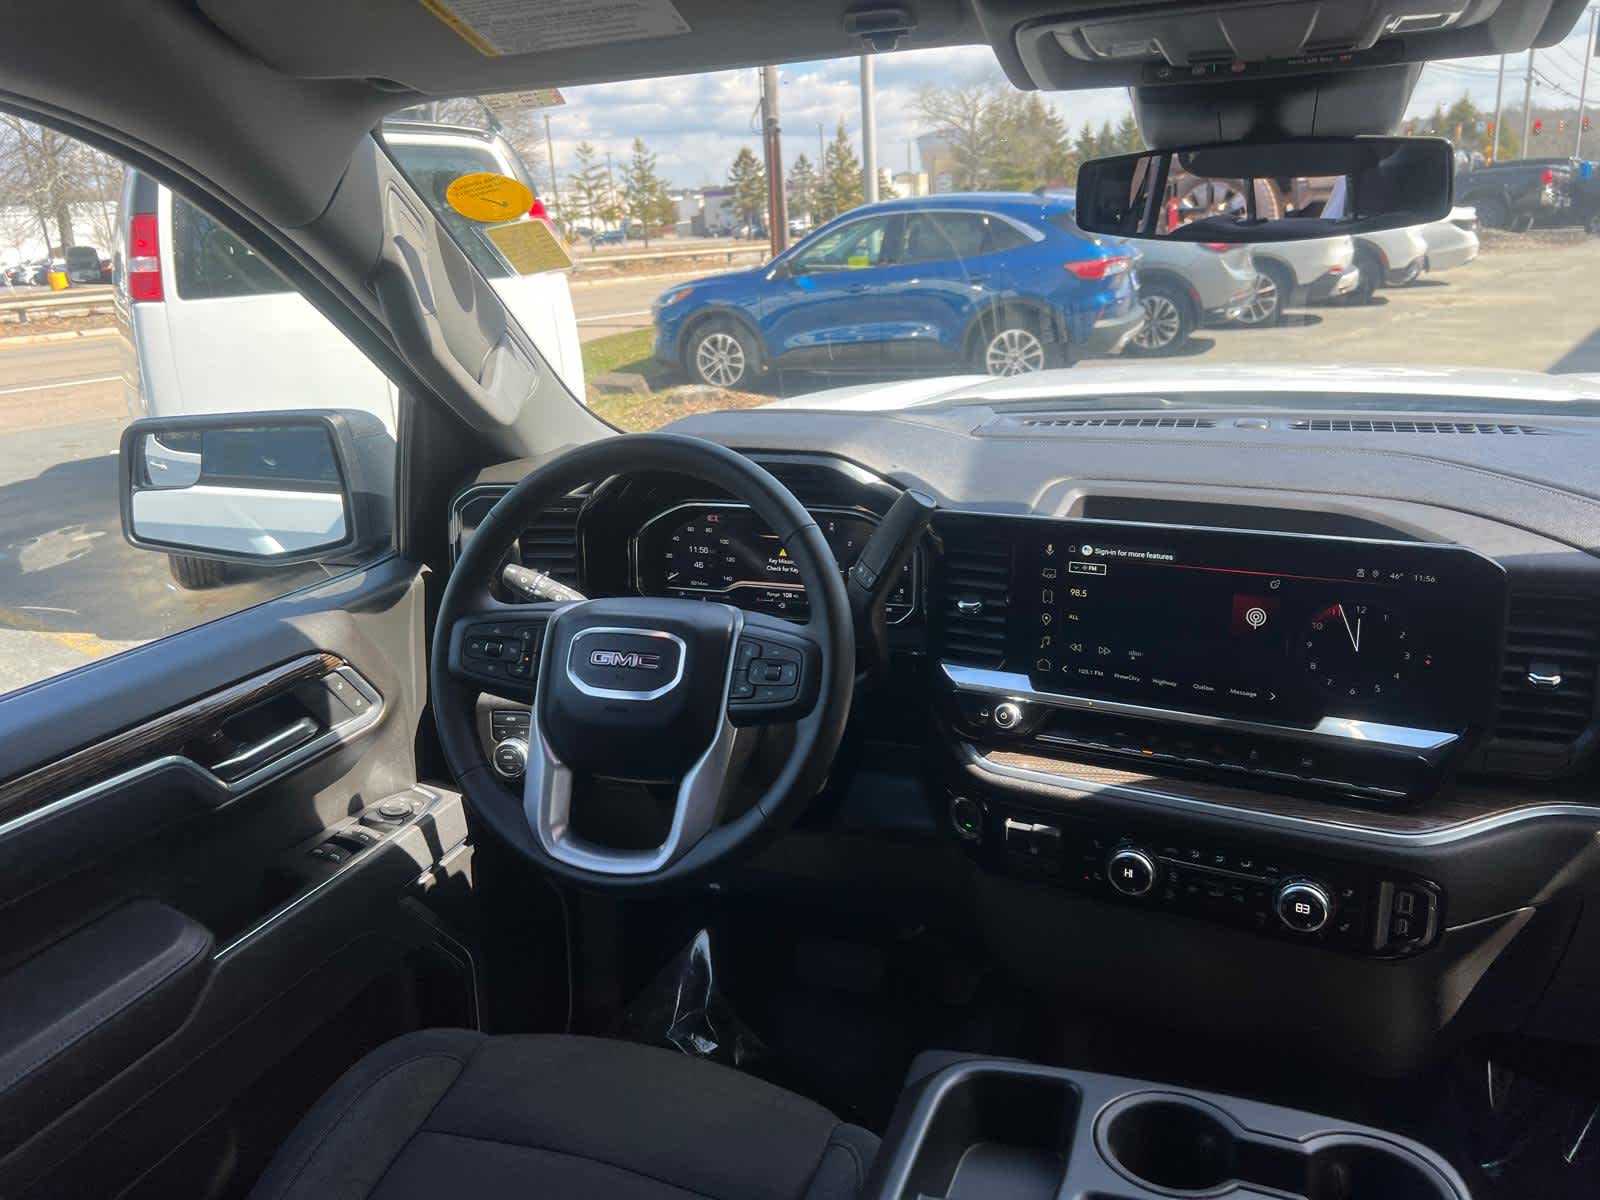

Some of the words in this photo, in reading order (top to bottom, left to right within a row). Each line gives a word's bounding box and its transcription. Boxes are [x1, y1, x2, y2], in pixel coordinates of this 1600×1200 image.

[1094, 547, 1117, 557] Sign-in
[1117, 549, 1128, 557] for
[1127, 551, 1146, 559] more
[1146, 551, 1174, 561] features
[768, 557, 778, 565] Key
[1414, 574, 1436, 584] 11:56
[1069, 587, 1088, 598] 98.5
[1355, 604, 1368, 614] 12
[1311, 621, 1324, 631] 10
[1399, 631, 1406, 639] 2
[1306, 641, 1313, 649] 9
[591, 651, 660, 669] GMC
[1404, 652, 1411, 660] 3
[1309, 662, 1317, 670] 8
[1393, 672, 1400, 680] 4
[1327, 678, 1333, 686] 7
[1349, 687, 1356, 695] 6
[1374, 684, 1381, 693] 5
[1124, 867, 1134, 879] HI
